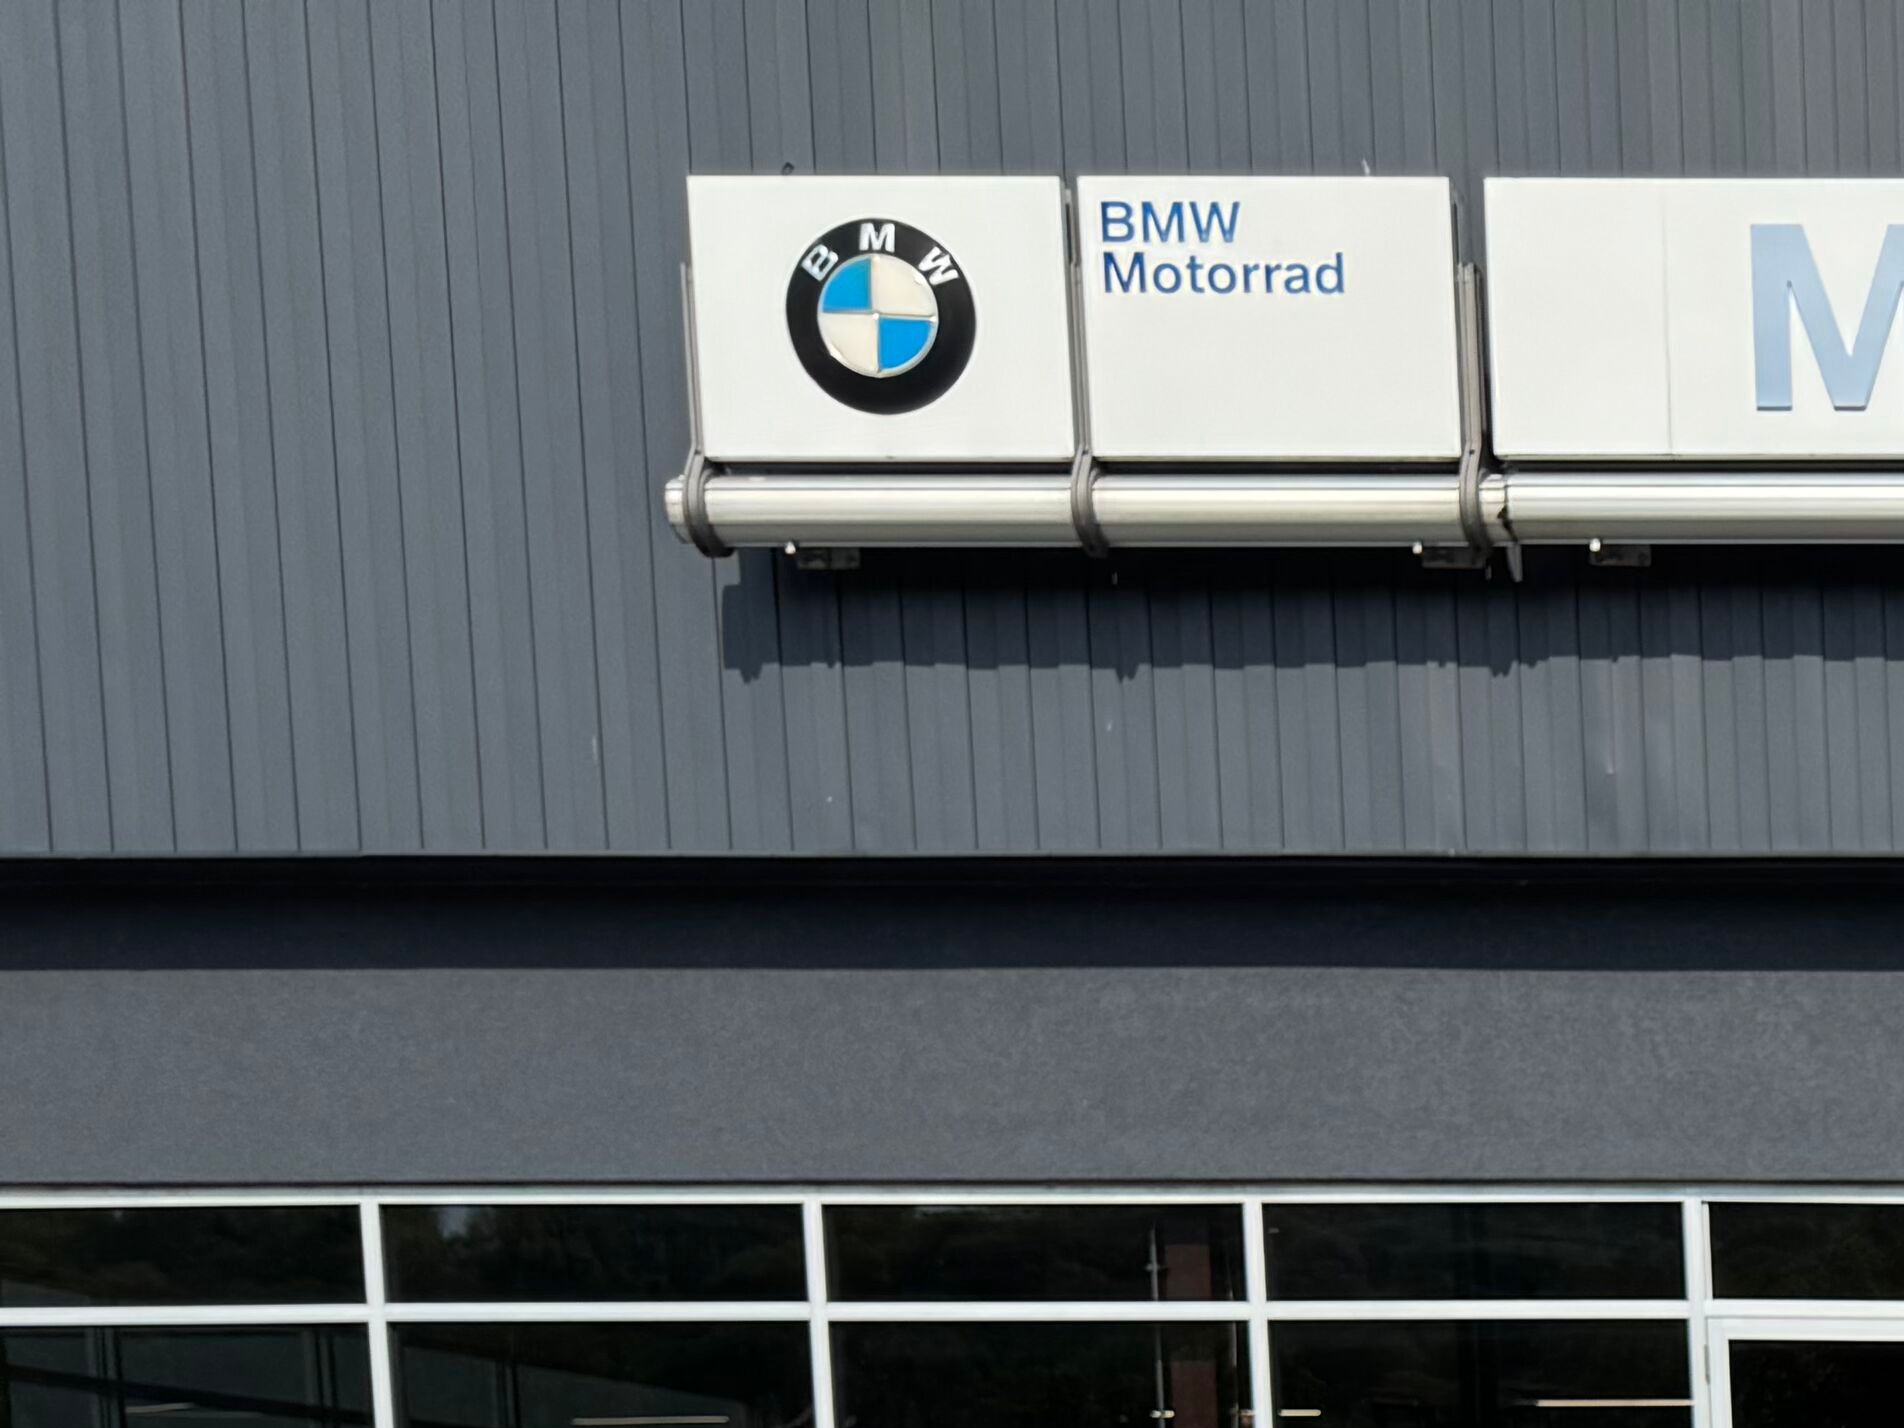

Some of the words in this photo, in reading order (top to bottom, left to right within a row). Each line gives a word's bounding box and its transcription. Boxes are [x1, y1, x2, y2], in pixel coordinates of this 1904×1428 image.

[1101, 201, 1241, 244] BMW
[800, 222, 959, 286] BMW
[1102, 252, 1345, 295] Motorrad
